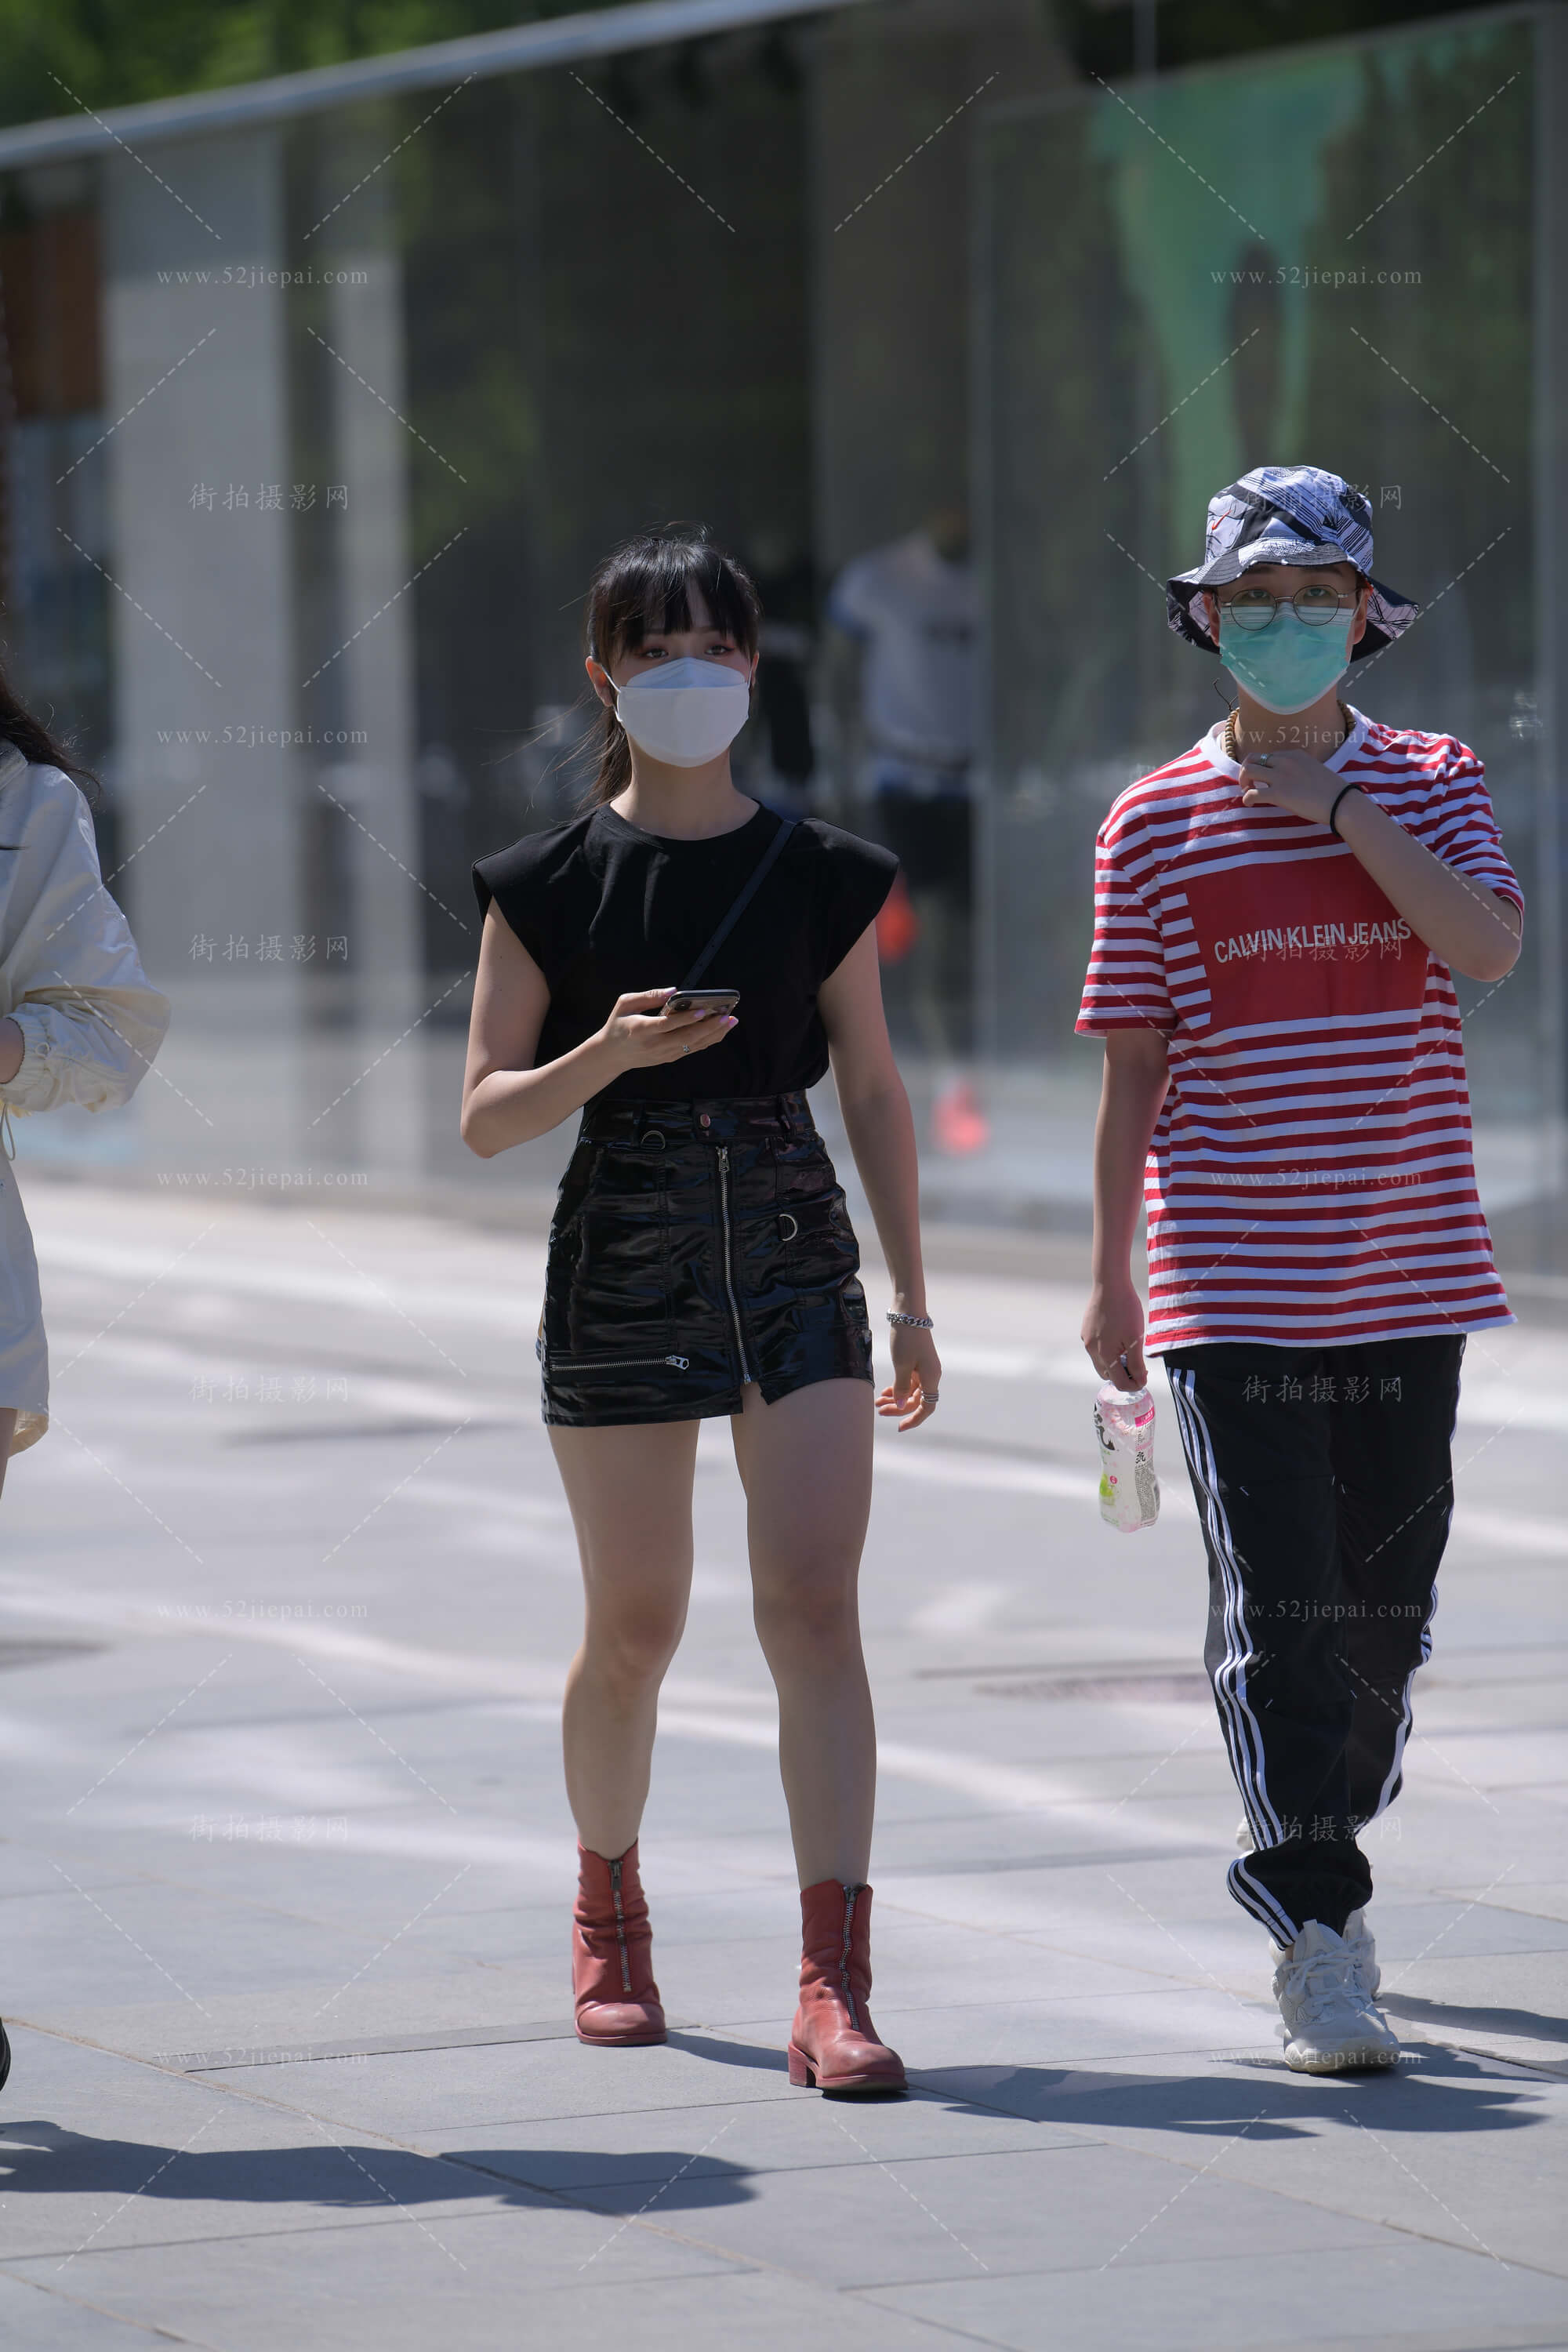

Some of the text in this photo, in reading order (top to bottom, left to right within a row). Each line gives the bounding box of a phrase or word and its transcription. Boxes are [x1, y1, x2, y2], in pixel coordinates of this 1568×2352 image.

[1214, 917, 1412, 964] CALVIN KLEIN JEANS
